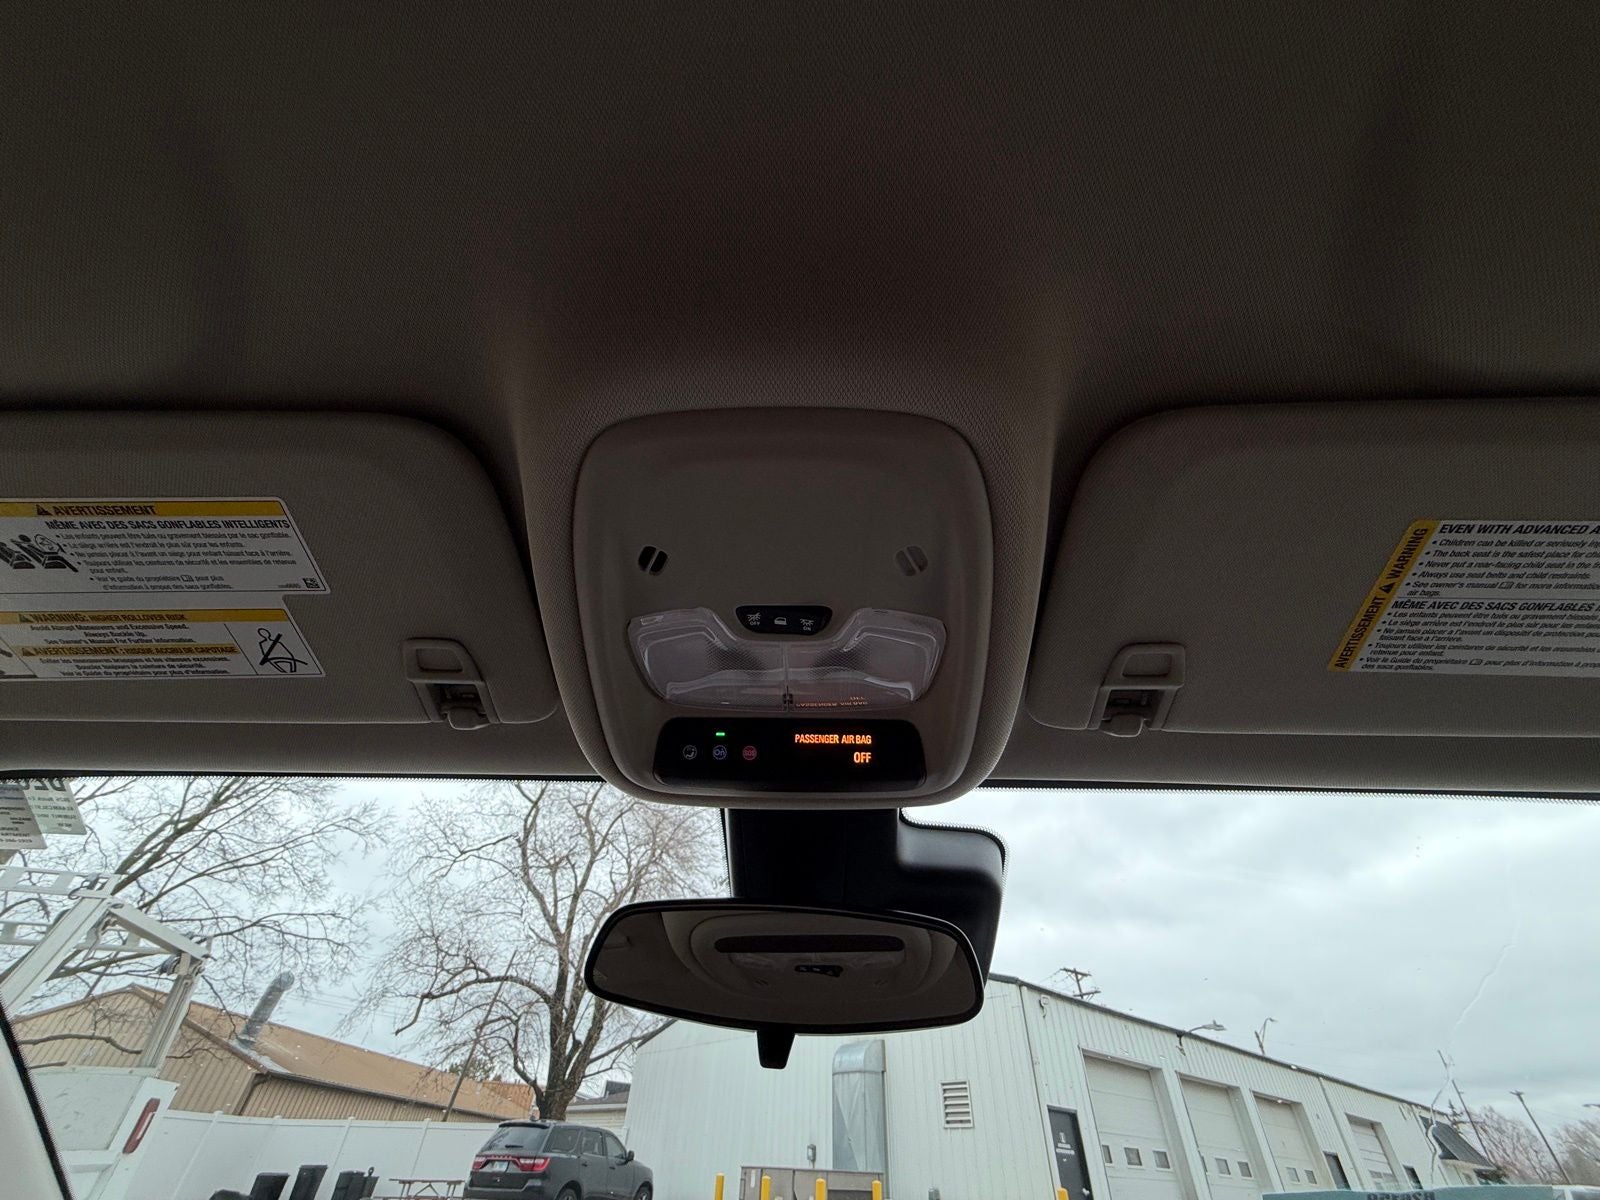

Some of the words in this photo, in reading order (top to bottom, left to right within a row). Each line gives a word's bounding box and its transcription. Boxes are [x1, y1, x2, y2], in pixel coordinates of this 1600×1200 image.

[53, 505, 156, 516] AVERTISSEMENT
[45, 520, 78, 529] MÊME
[79, 520, 106, 529] AVEC
[107, 520, 128, 529] DES
[129, 520, 156, 529] SACS
[157, 520, 222, 528] GONFLABLES
[222, 520, 290, 528] INTELLIGENTS
[1439, 525, 1475, 534] EVEN
[1477, 525, 1513, 534] WITH
[1513, 525, 1590, 534] ADVANCED
[1386, 528, 1429, 580] WARNING
[1545, 551, 1570, 559] place
[1450, 561, 1469, 569] put
[1391, 600, 1427, 609] MÊME
[1427, 602, 1459, 610] AVEC
[1460, 602, 1484, 610] DES
[1485, 602, 1518, 610] SACS
[1518, 602, 1595, 611] GONFLABLES
[30, 614, 86, 622] WARNING:
[1334, 596, 1386, 668] AVERTISSEMENT
[794, 734, 838, 744] PASSENGER
[841, 734, 854, 744] AIR
[856, 734, 872, 744] BAG
[854, 752, 872, 763] OFF
